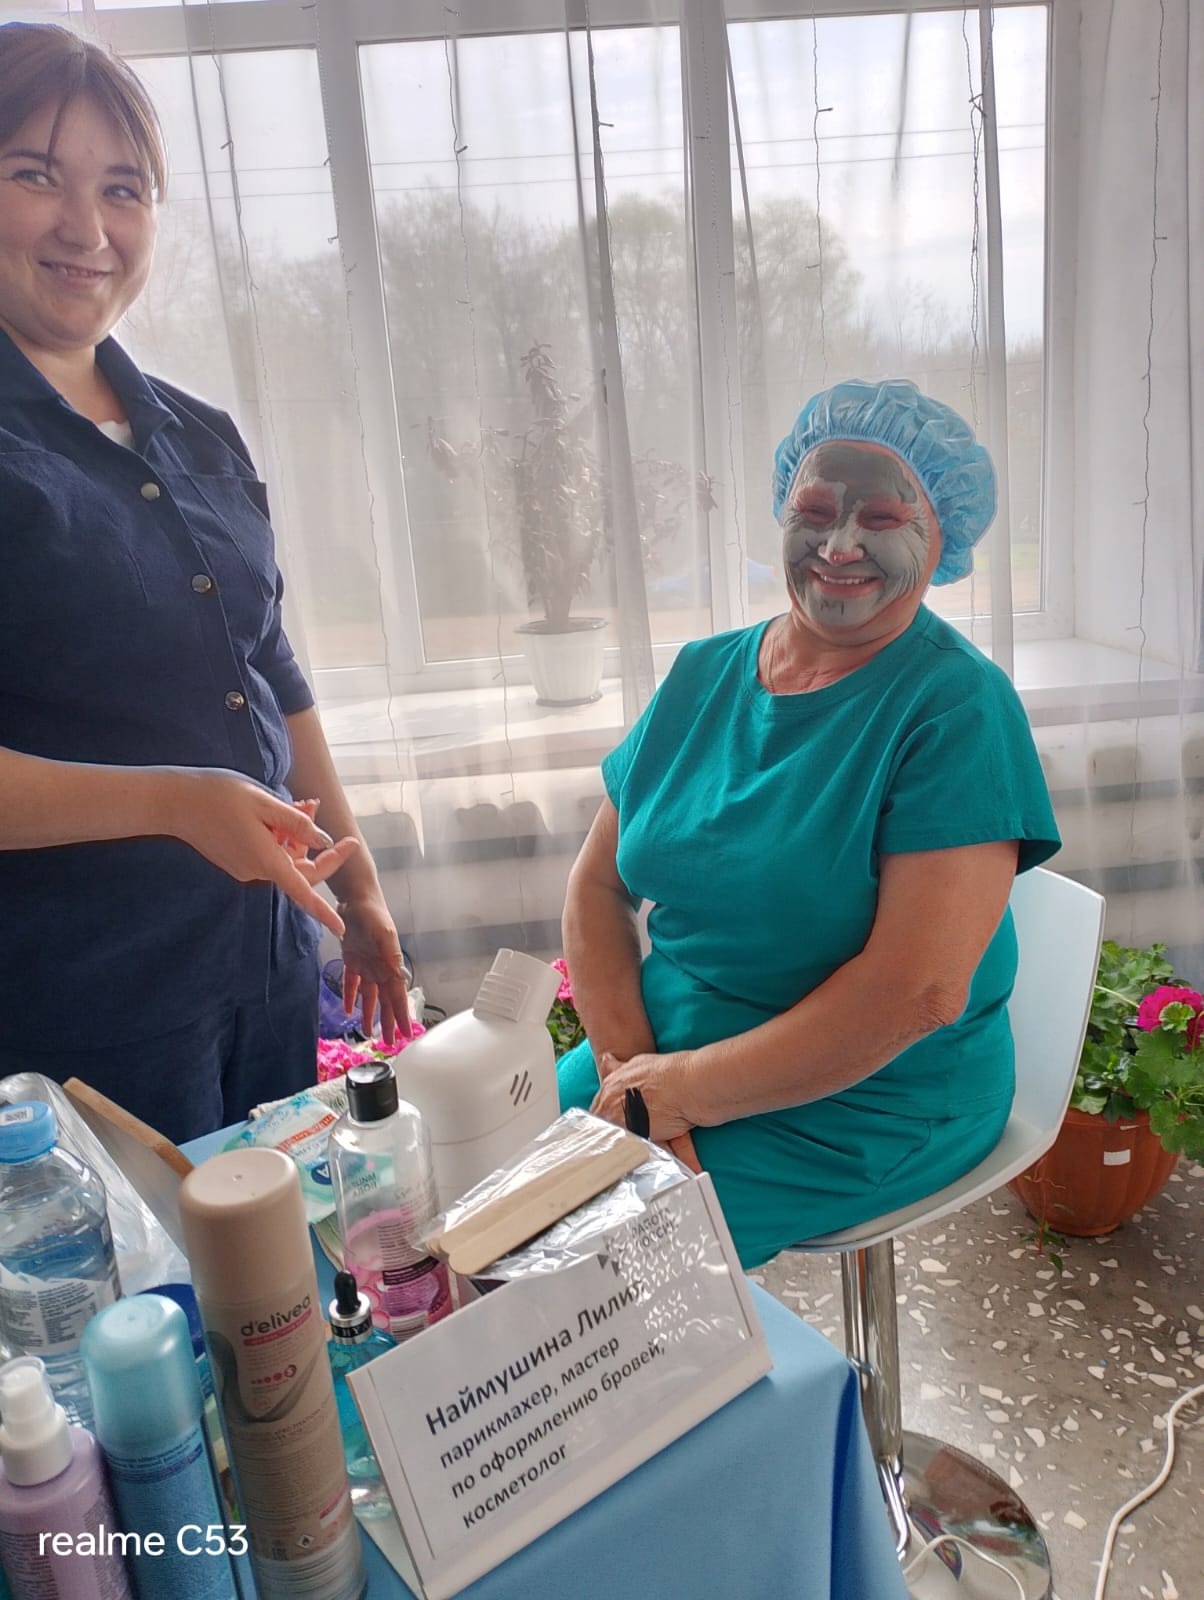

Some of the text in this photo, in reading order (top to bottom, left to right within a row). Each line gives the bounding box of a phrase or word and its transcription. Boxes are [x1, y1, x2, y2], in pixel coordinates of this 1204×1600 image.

[425, 1328, 573, 1436] Наймушина
[440, 1337, 620, 1469] парикмахер, мастер
[451, 1340, 666, 1499] по оформлению бровей,
[463, 1444, 568, 1529] косметолог
